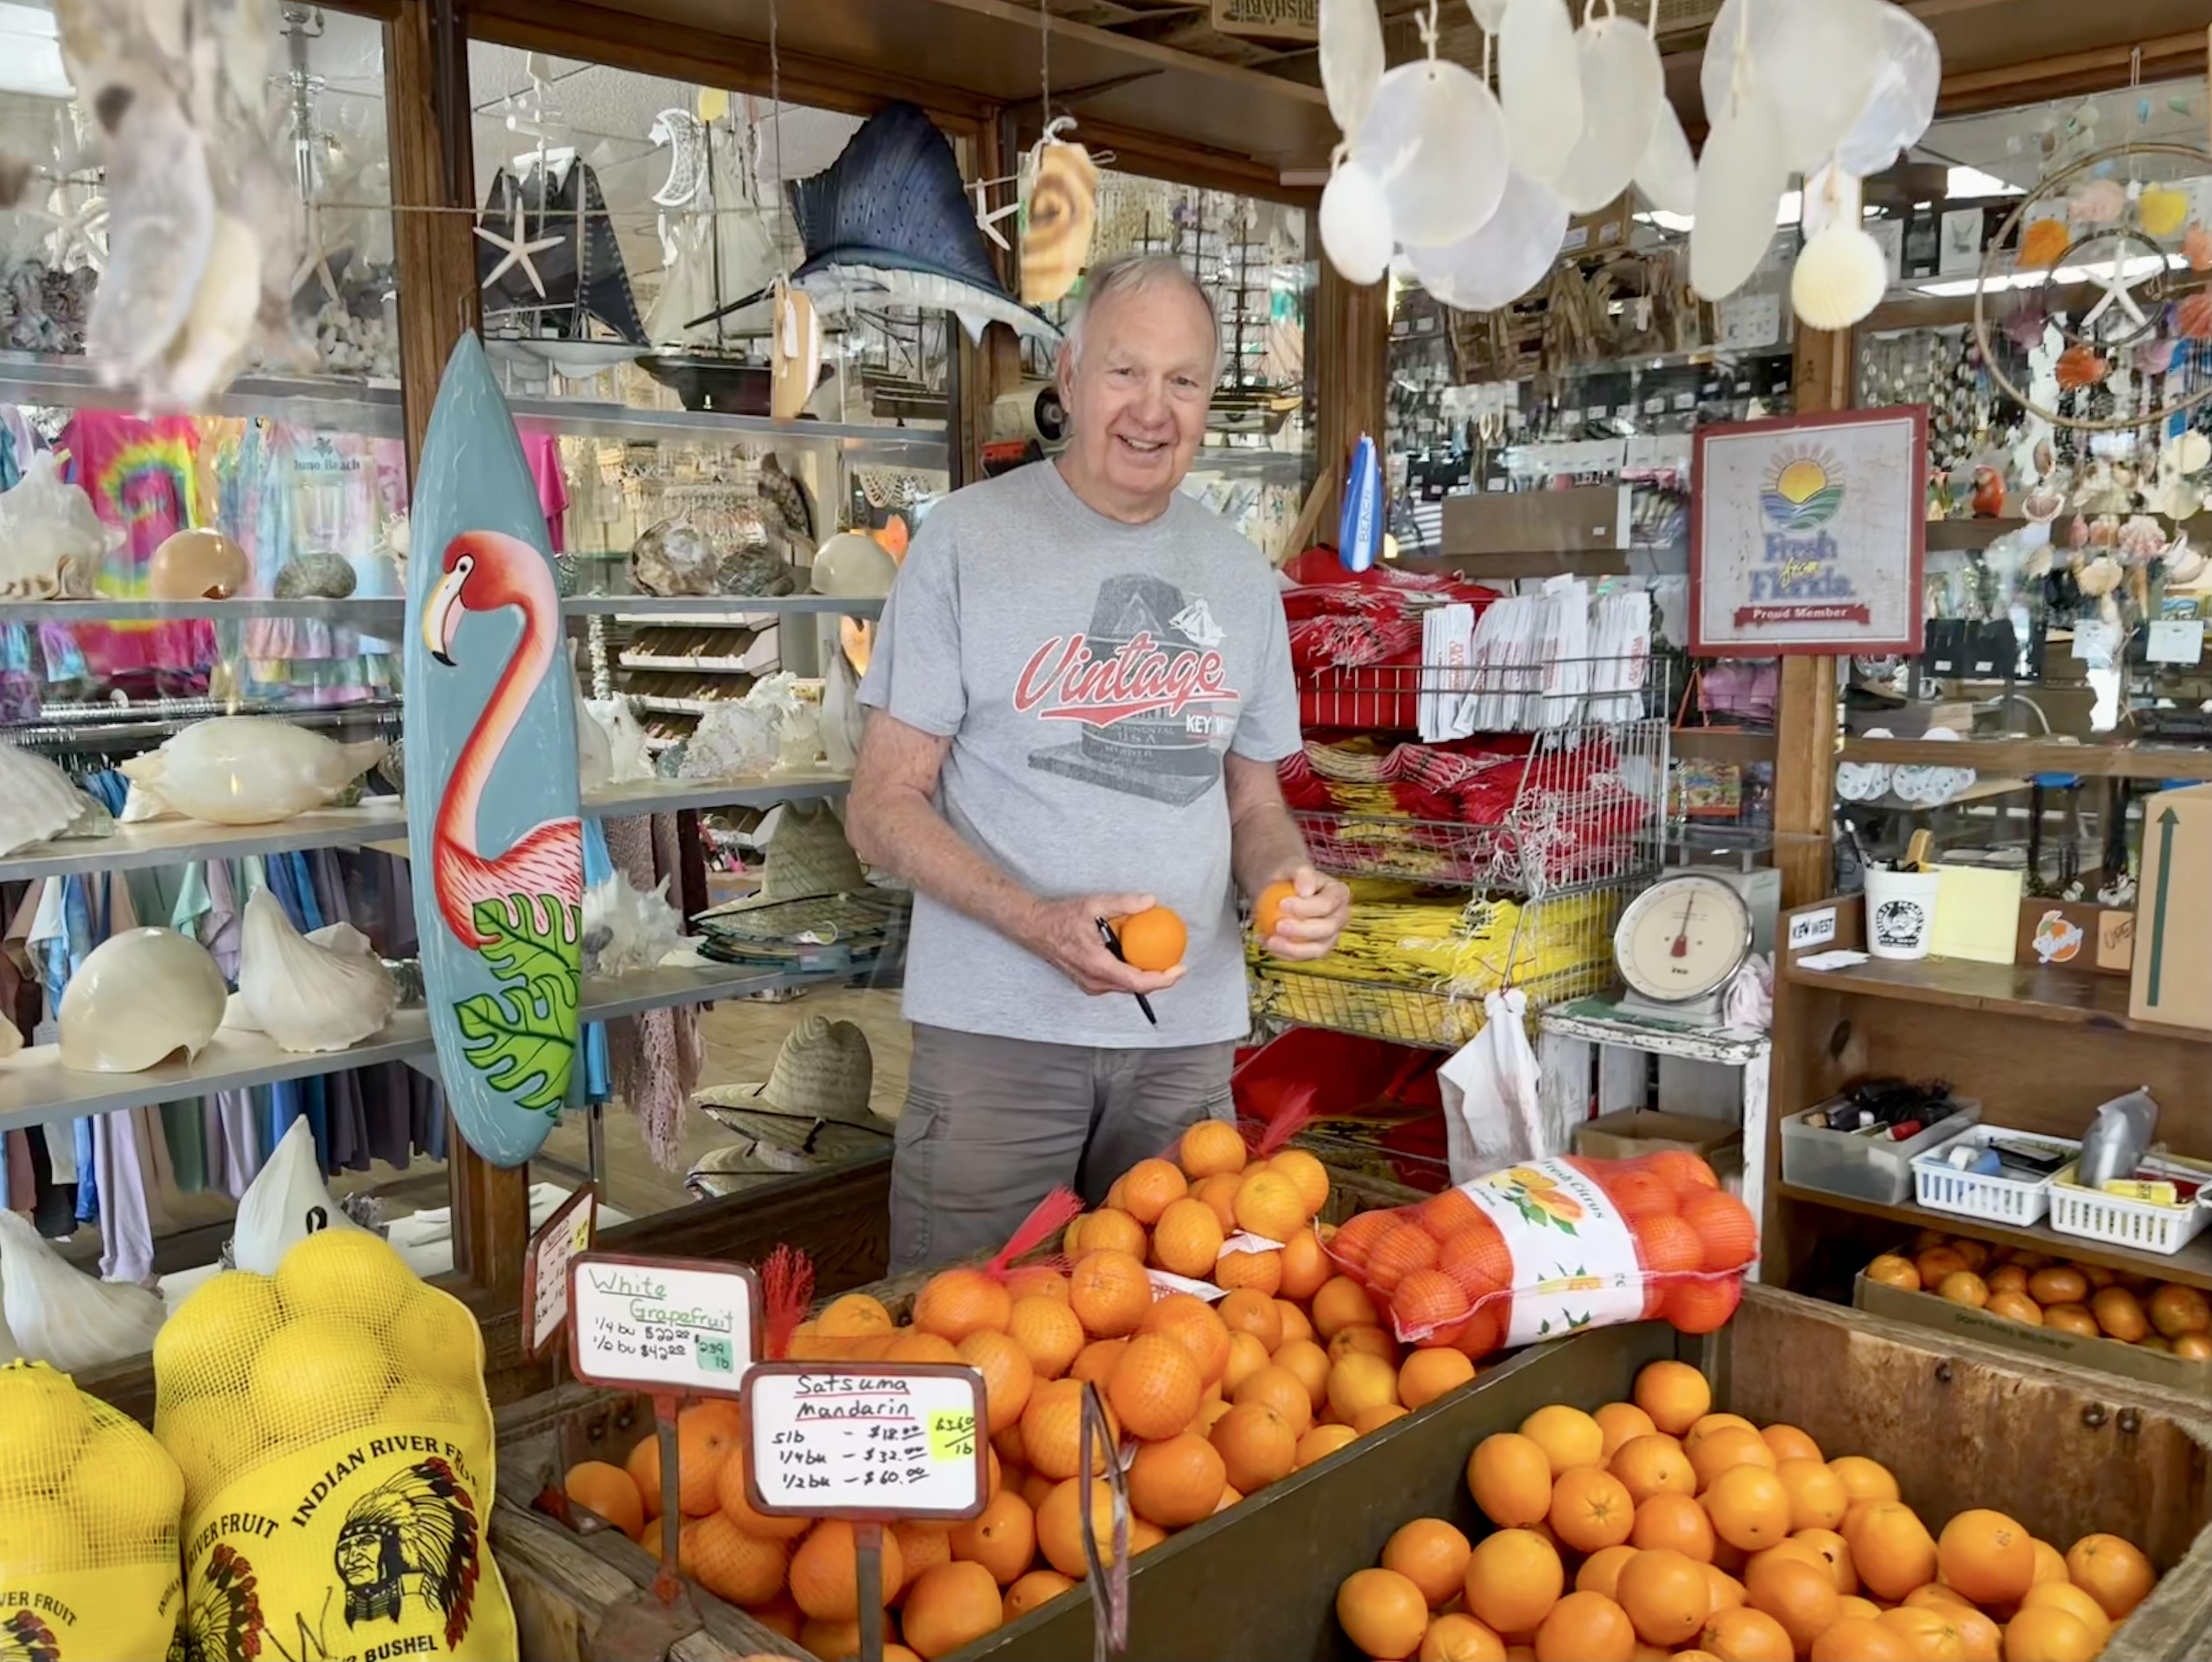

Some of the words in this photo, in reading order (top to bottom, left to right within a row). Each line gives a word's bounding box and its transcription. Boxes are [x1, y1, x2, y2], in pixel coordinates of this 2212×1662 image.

[1765, 530, 1839, 562] Fresh
[1752, 608, 1790, 620] Proud
[1794, 606, 1848, 618] Member
[1012, 631, 1241, 727] Vintage
[1186, 714, 1212, 734] KEY
[1571, 1180, 1606, 1219] Citrus
[588, 1268, 668, 1298] White
[630, 1298, 734, 1332] Grapefruit
[796, 1374, 910, 1394] Satsuma
[291, 1448, 365, 1528] INDIAN
[370, 1435, 439, 1459] RIVER
[221, 1513, 279, 1539] FRUIT
[33, 1593, 78, 1627] FRUIT
[364, 1634, 439, 1662] BUSHEL
